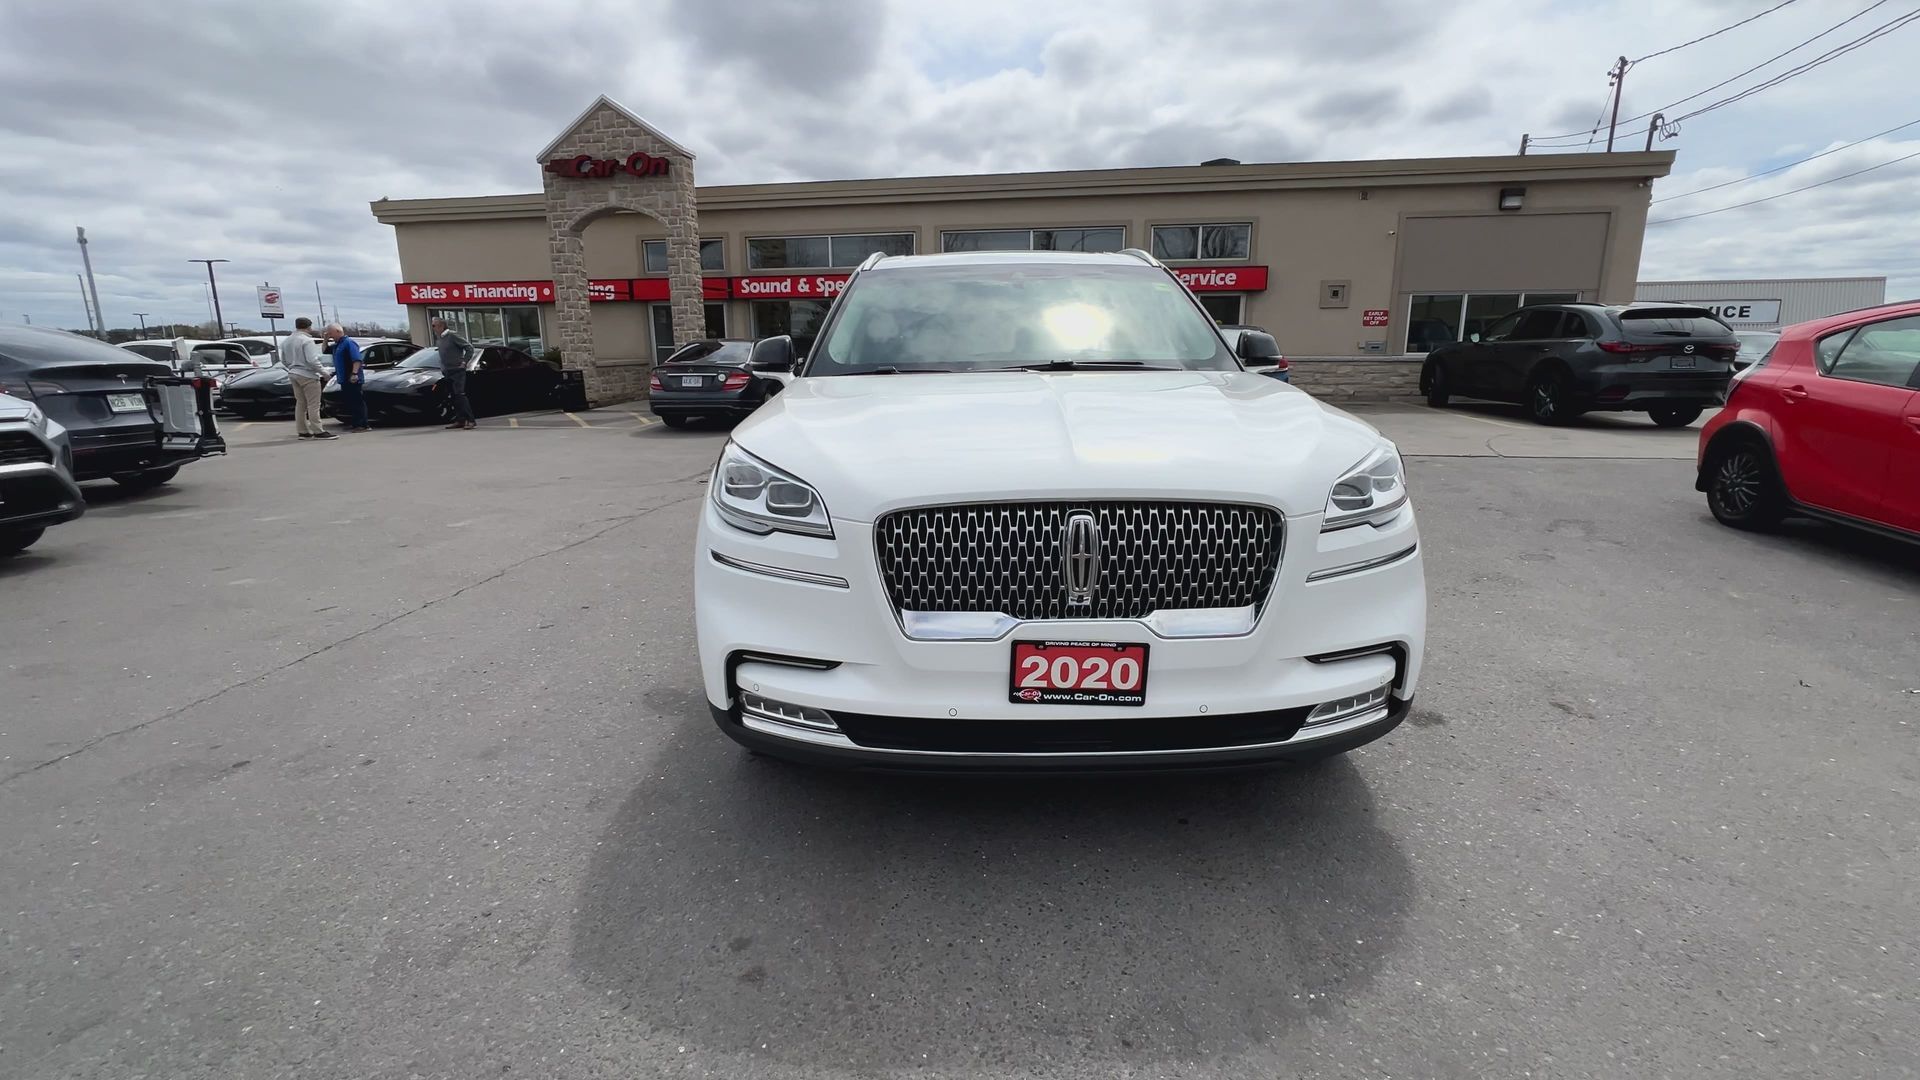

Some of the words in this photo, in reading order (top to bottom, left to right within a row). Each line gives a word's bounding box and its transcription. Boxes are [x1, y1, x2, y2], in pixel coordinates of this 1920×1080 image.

[410, 285, 447, 299] Sales
[464, 283, 537, 302] Financing
[587, 281, 615, 300] ing
[741, 278, 791, 294] Sound
[797, 277, 810, 293] &
[815, 277, 845, 297] Spe
[1020, 655, 1140, 690] 2020
[1043, 693, 1142, 702] www.Car-On.com
